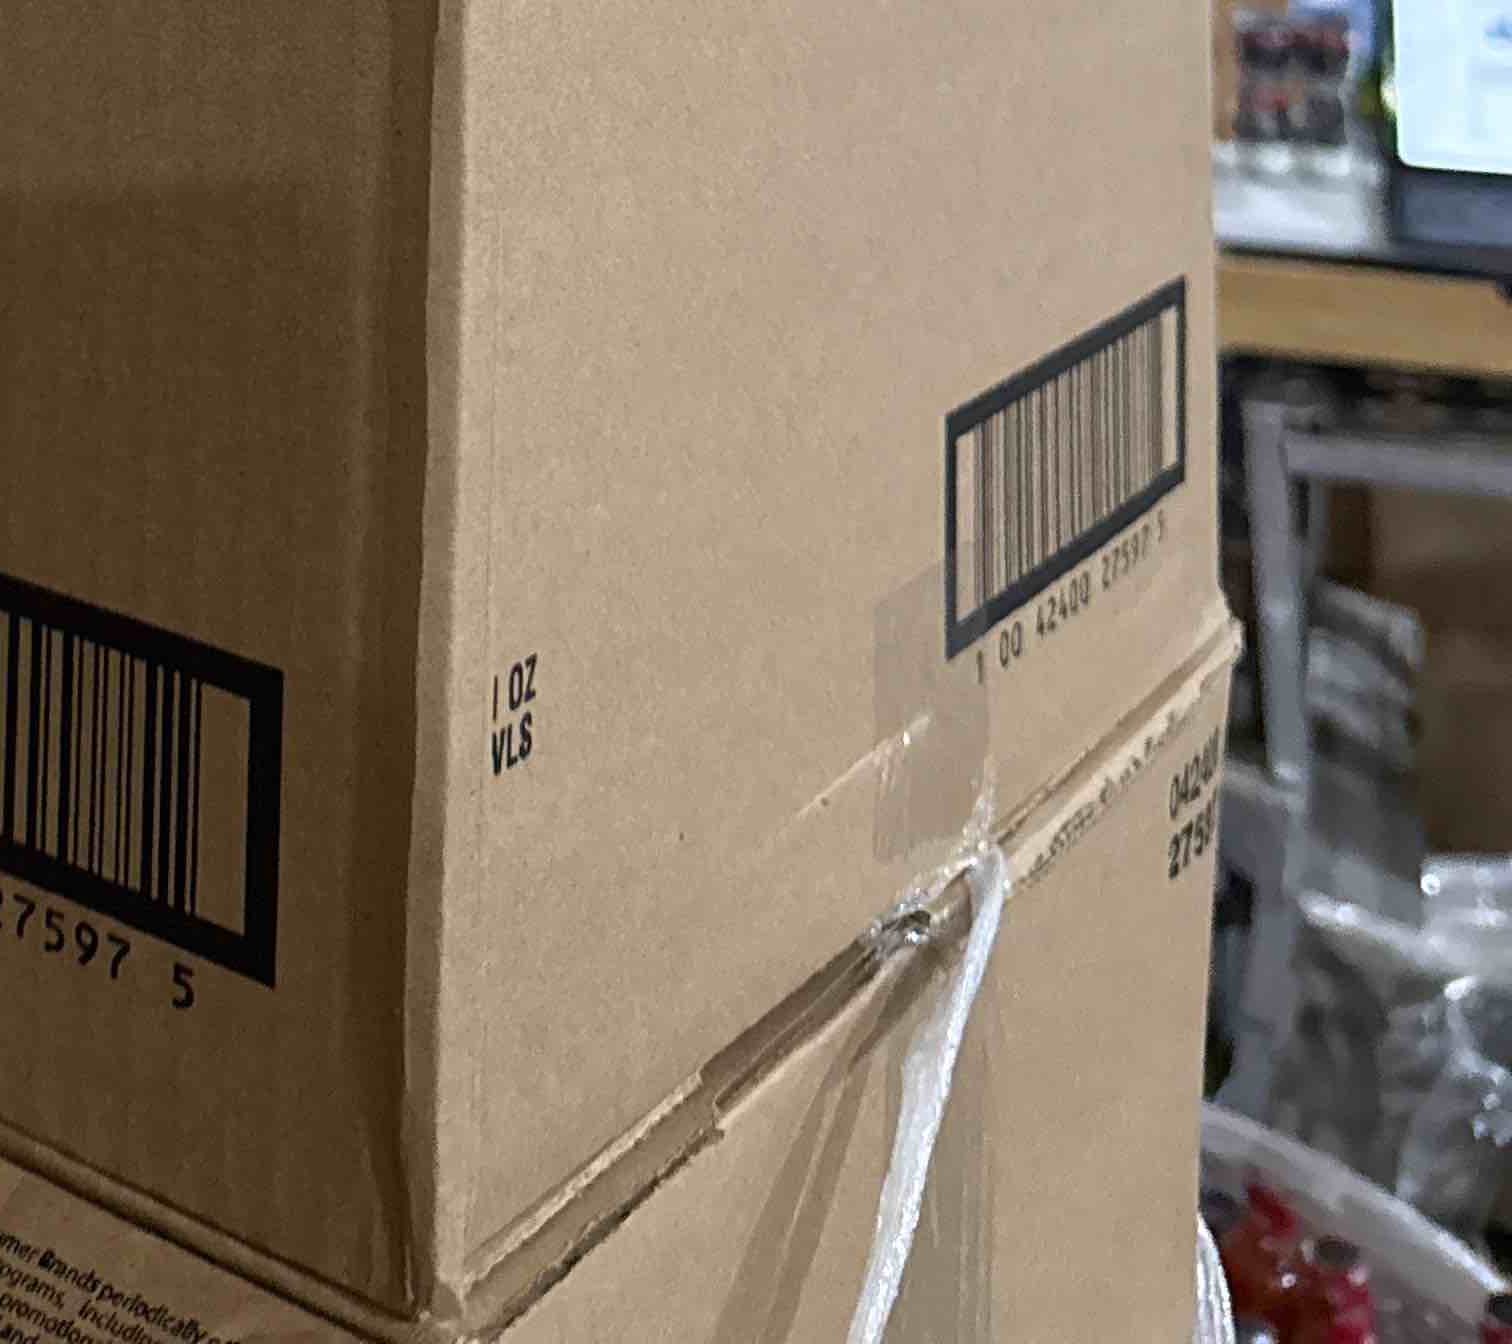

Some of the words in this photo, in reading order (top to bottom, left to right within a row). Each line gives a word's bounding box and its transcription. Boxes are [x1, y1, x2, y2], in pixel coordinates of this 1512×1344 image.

[998, 621, 1023, 669] 00
[1035, 570, 1092, 638] 42400
[1101, 522, 1151, 590] 27597
[508, 652, 538, 711] OZ
[491, 711, 533, 777] VLS
[170, 963, 195, 1009] 5
[40, 1249, 102, 1294] Brands
[97, 1284, 207, 1339] periodically
